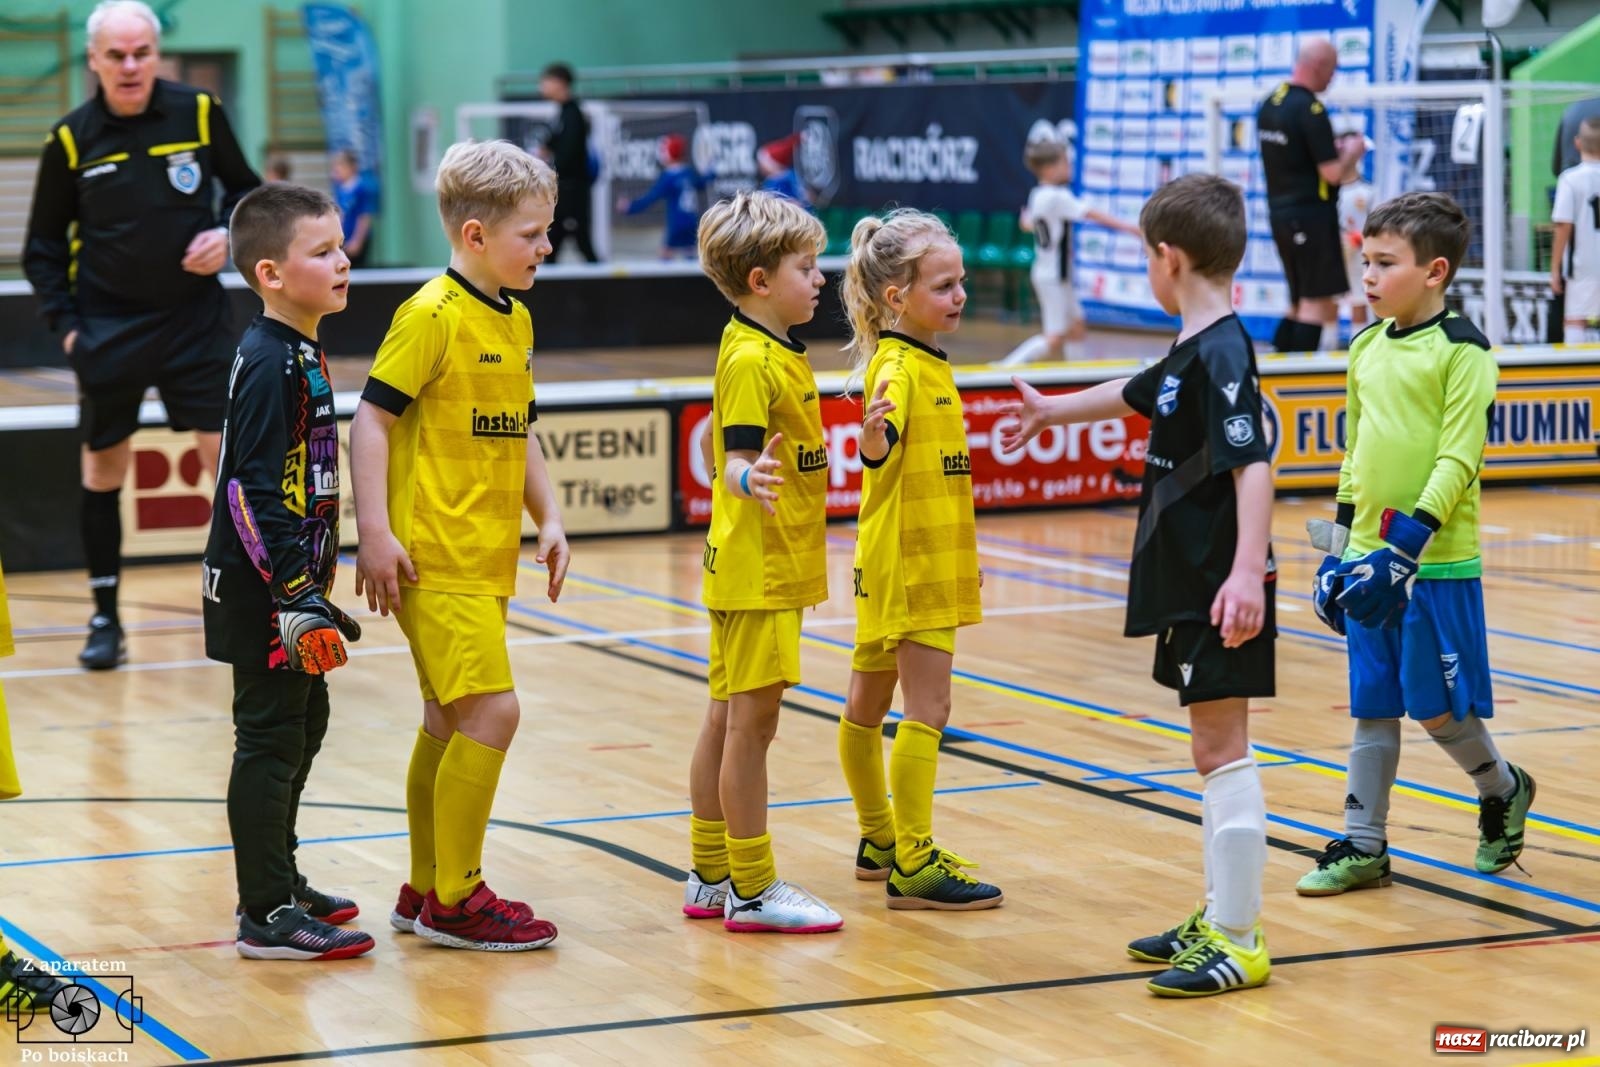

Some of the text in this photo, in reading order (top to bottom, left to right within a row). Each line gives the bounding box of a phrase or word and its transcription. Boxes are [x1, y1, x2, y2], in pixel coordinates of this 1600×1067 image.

[853, 122, 979, 183] RACIBÓRZ
[1462, 299, 1550, 343] TXI
[478, 353, 502, 364] JAKO
[315, 405, 330, 418] JAK
[935, 396, 952, 406] JAKO
[472, 407, 527, 437] instal-t
[1298, 399, 1600, 452] FLO HUMIN.
[797, 444, 828, 471] inst
[940, 450, 970, 475] insta
[1042, 474, 1082, 500] golf
